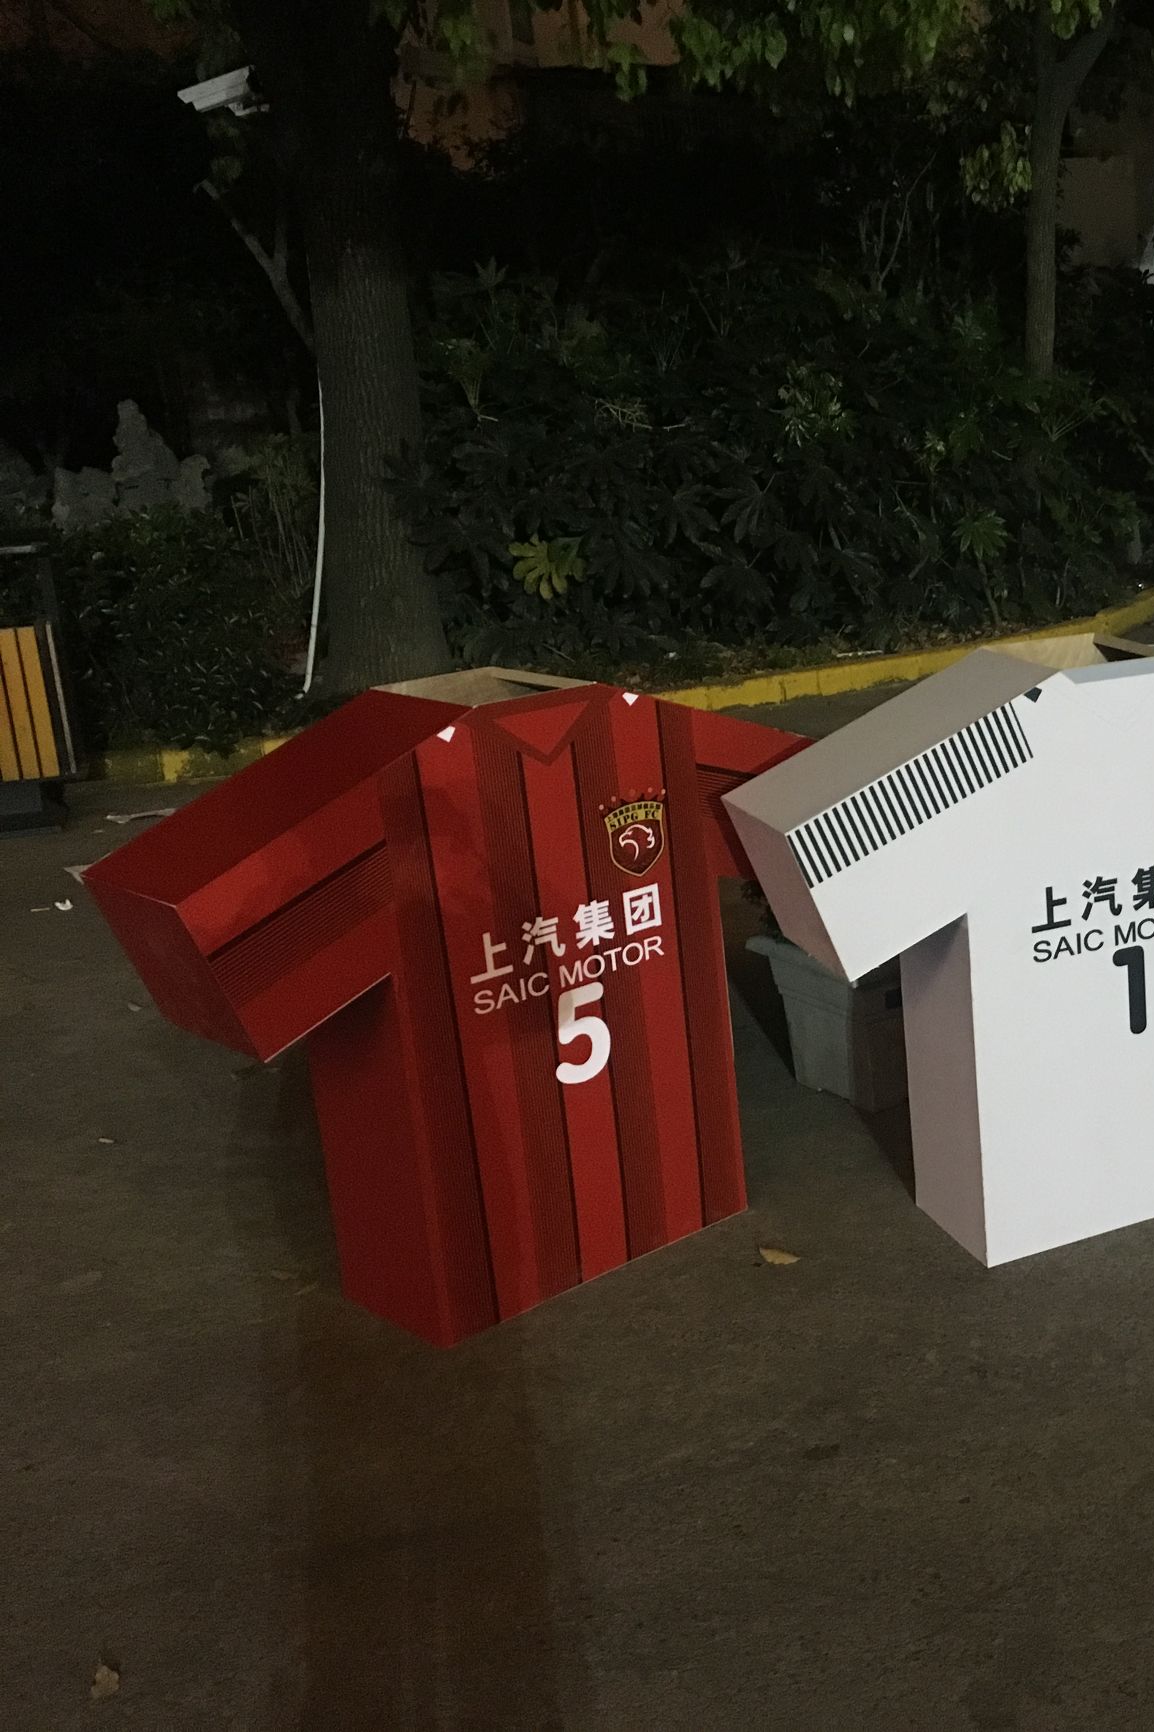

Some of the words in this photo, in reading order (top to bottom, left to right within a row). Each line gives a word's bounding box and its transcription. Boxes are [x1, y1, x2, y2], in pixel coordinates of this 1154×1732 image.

[609, 811, 639, 829] SIPG
[645, 809, 658, 819] FC
[469, 883, 662, 984] 上汽集团
[473, 972, 550, 1015] SAIC
[559, 936, 665, 989] MOTOR
[1033, 929, 1105, 963] SAIC
[1112, 945, 1147, 1035] 1
[555, 982, 612, 1085] 5
